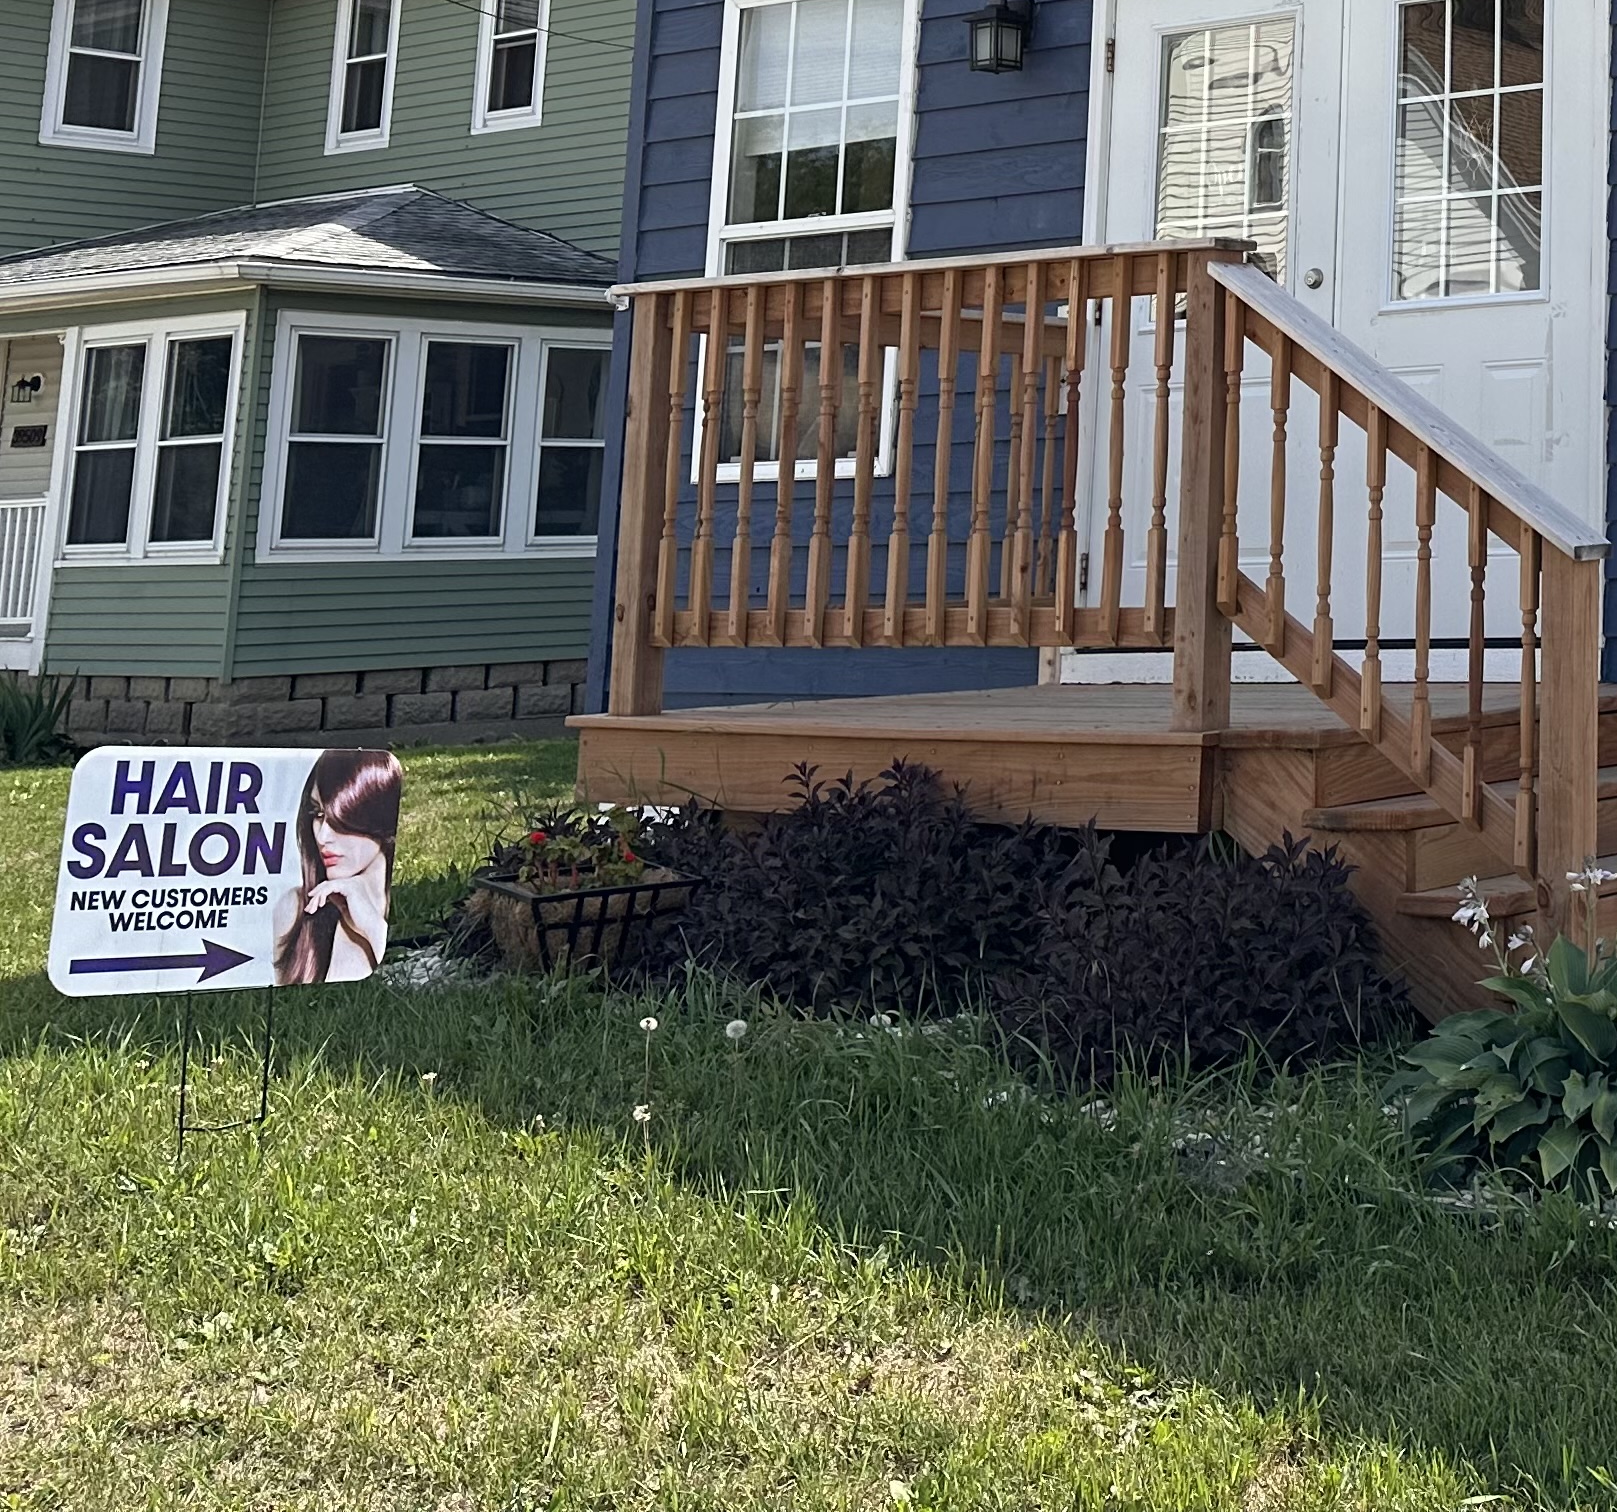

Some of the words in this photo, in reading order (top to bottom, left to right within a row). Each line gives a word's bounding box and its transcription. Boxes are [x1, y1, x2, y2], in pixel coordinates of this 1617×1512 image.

[110, 760, 263, 815] HAIR
[67, 822, 287, 879] SALON
[70, 890, 126, 911] NEW
[131, 886, 269, 909] CUSTOMERS
[109, 909, 229, 933] WELCOME
